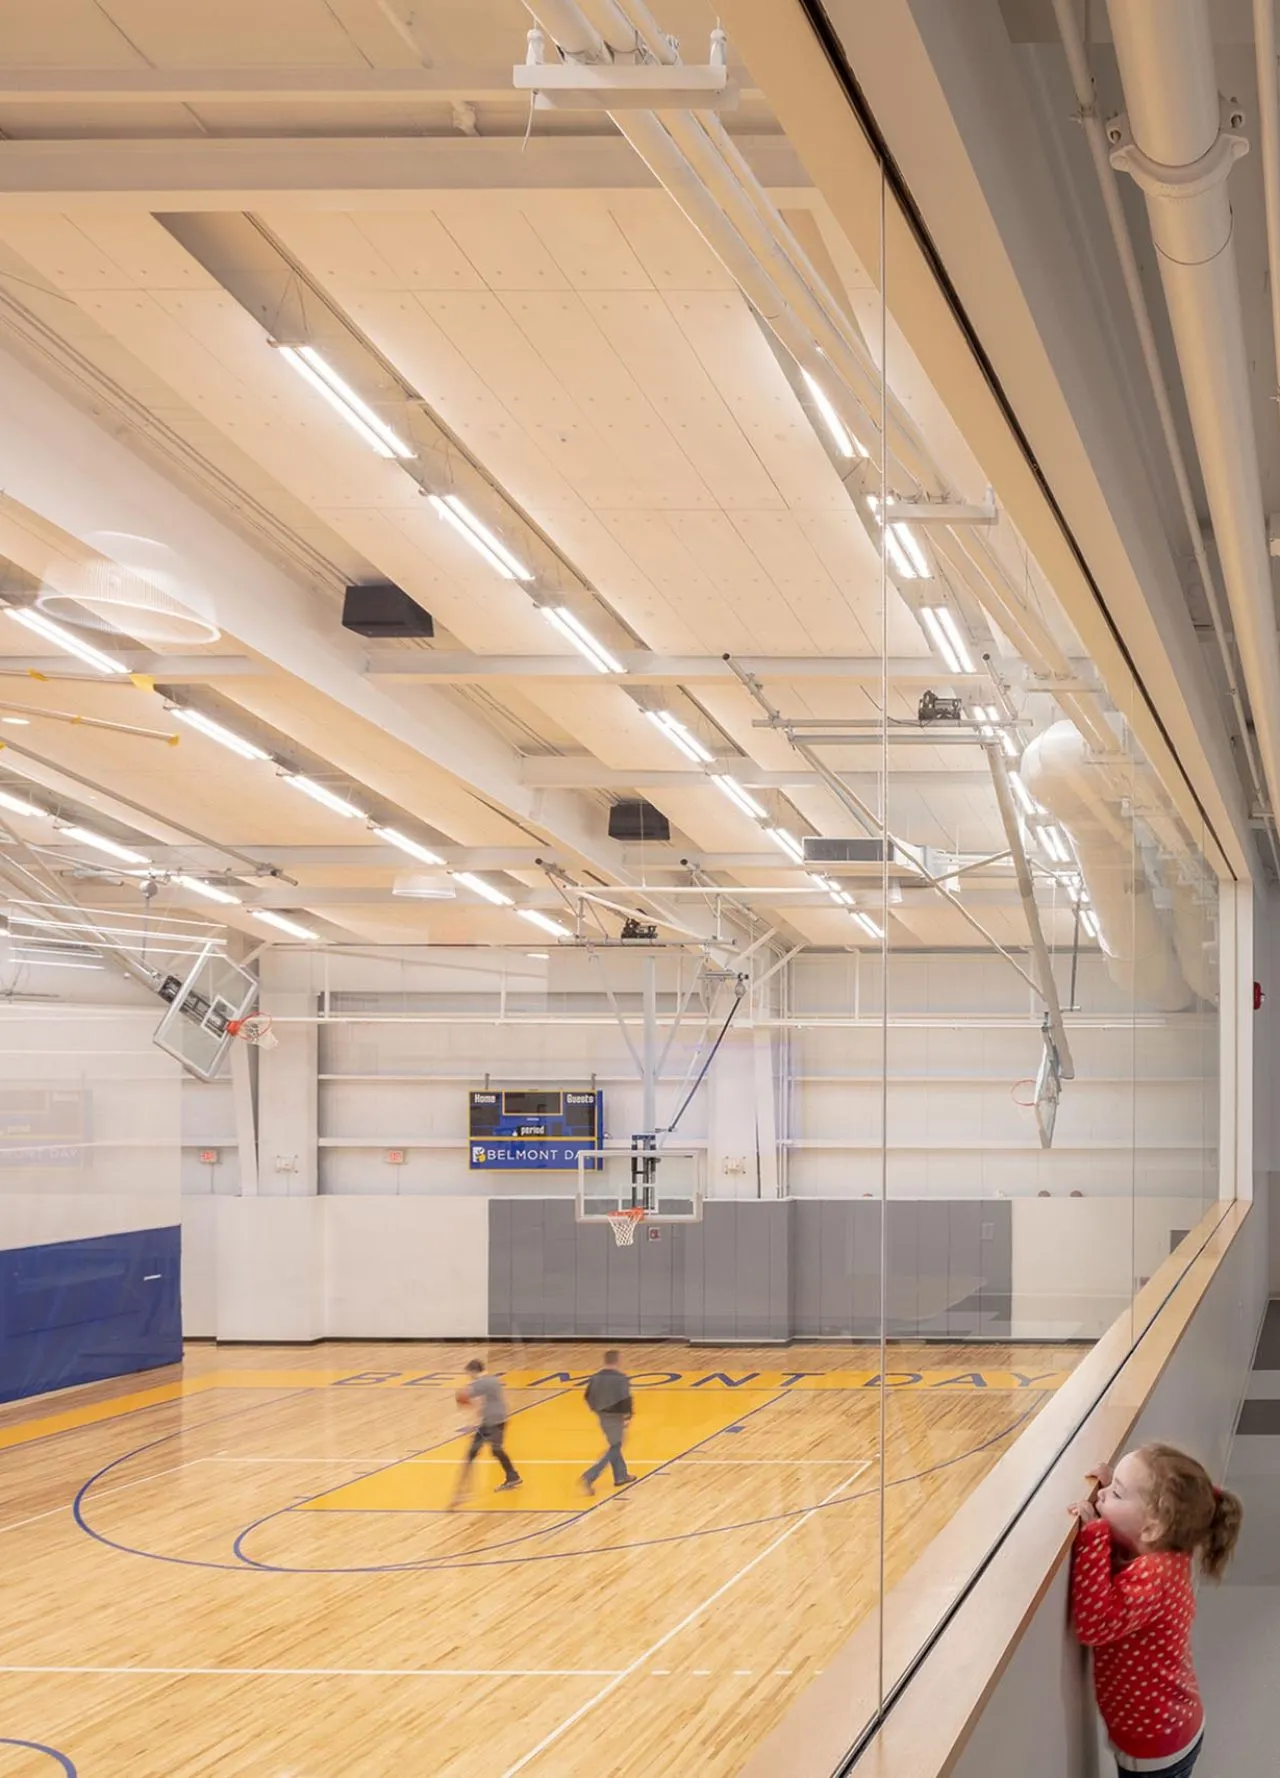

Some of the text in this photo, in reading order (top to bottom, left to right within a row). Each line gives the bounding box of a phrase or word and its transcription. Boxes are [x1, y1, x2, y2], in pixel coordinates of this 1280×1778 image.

[474, 1094, 496, 1103] Home
[566, 1094, 594, 1104] Guests
[520, 1126, 545, 1135] period
[487, 1149, 559, 1160] BELMONT
[862, 1371, 1058, 1387] DAY
